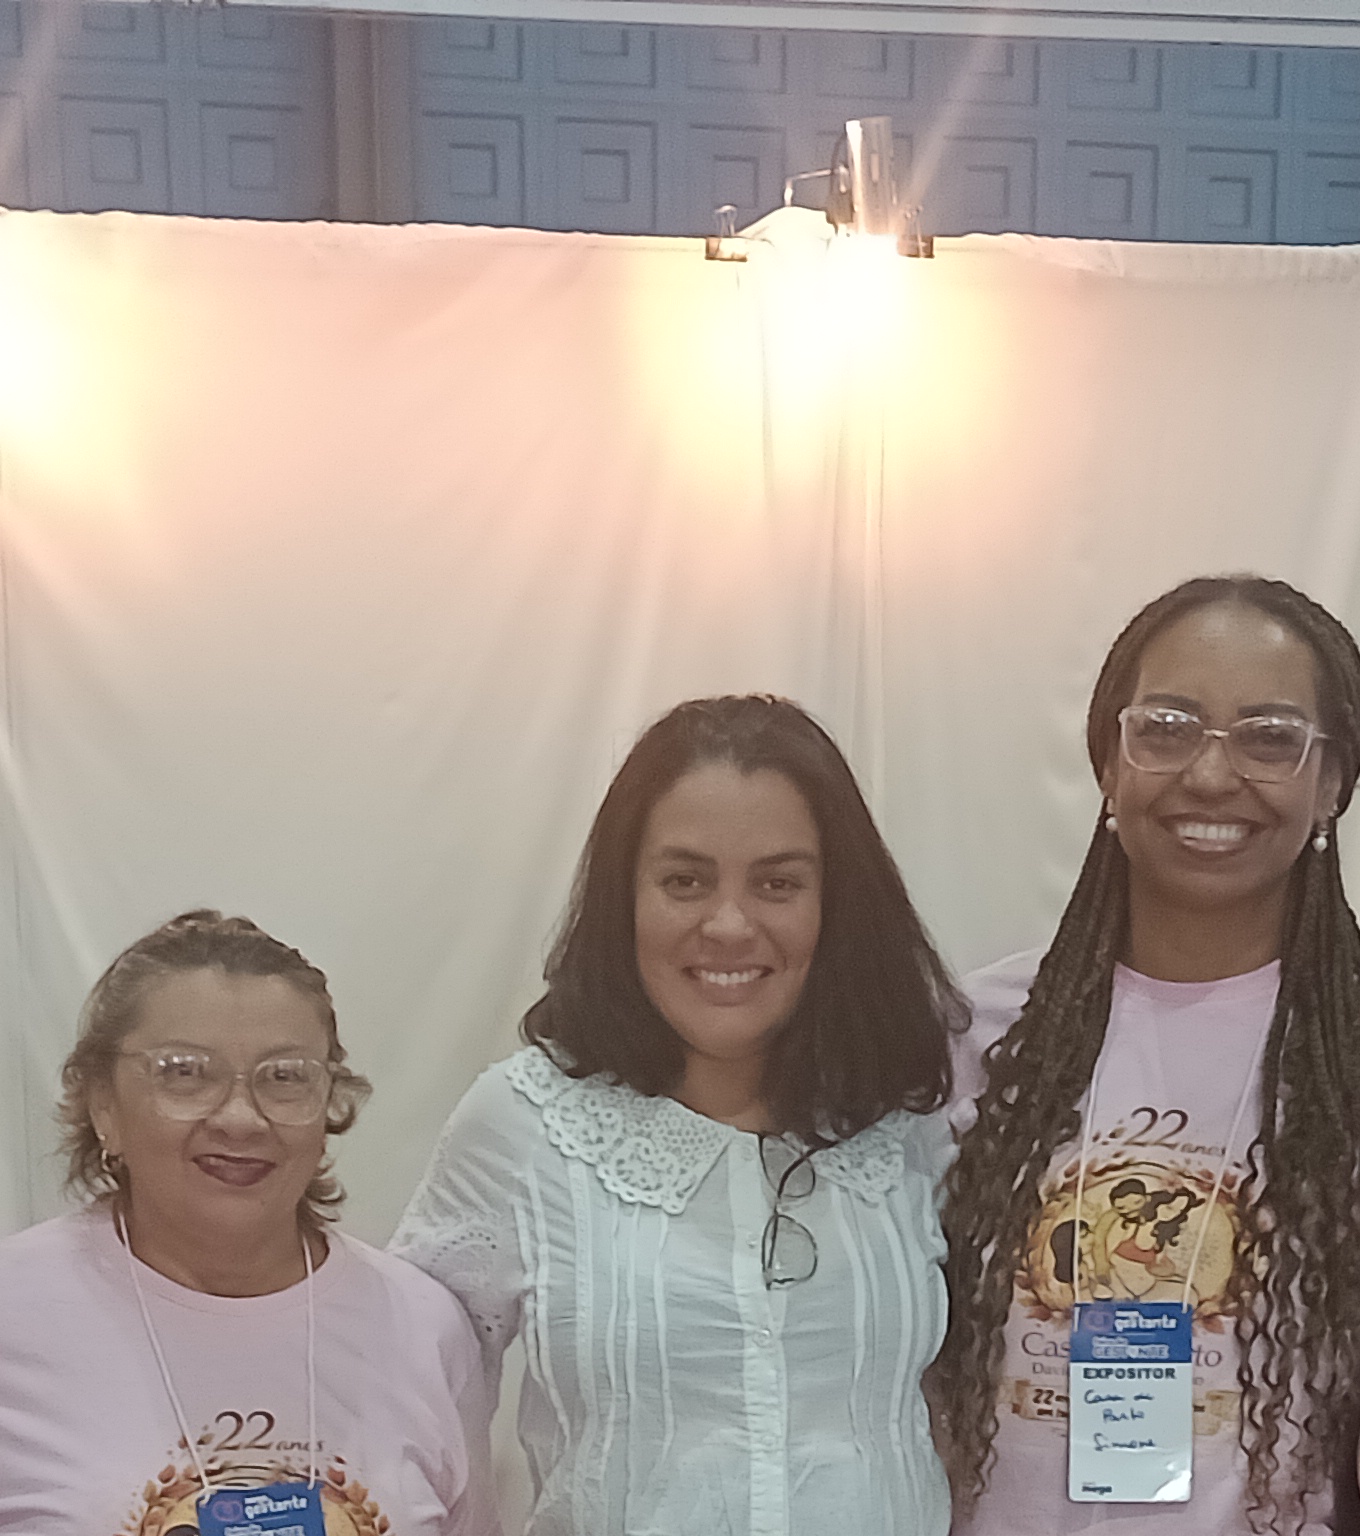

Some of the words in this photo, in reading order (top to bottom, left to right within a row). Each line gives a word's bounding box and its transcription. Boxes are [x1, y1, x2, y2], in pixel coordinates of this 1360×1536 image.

[1121, 1106, 1189, 1151] 22
[1083, 1367, 1176, 1379] EXPOSITOR
[213, 1411, 275, 1452] 22
